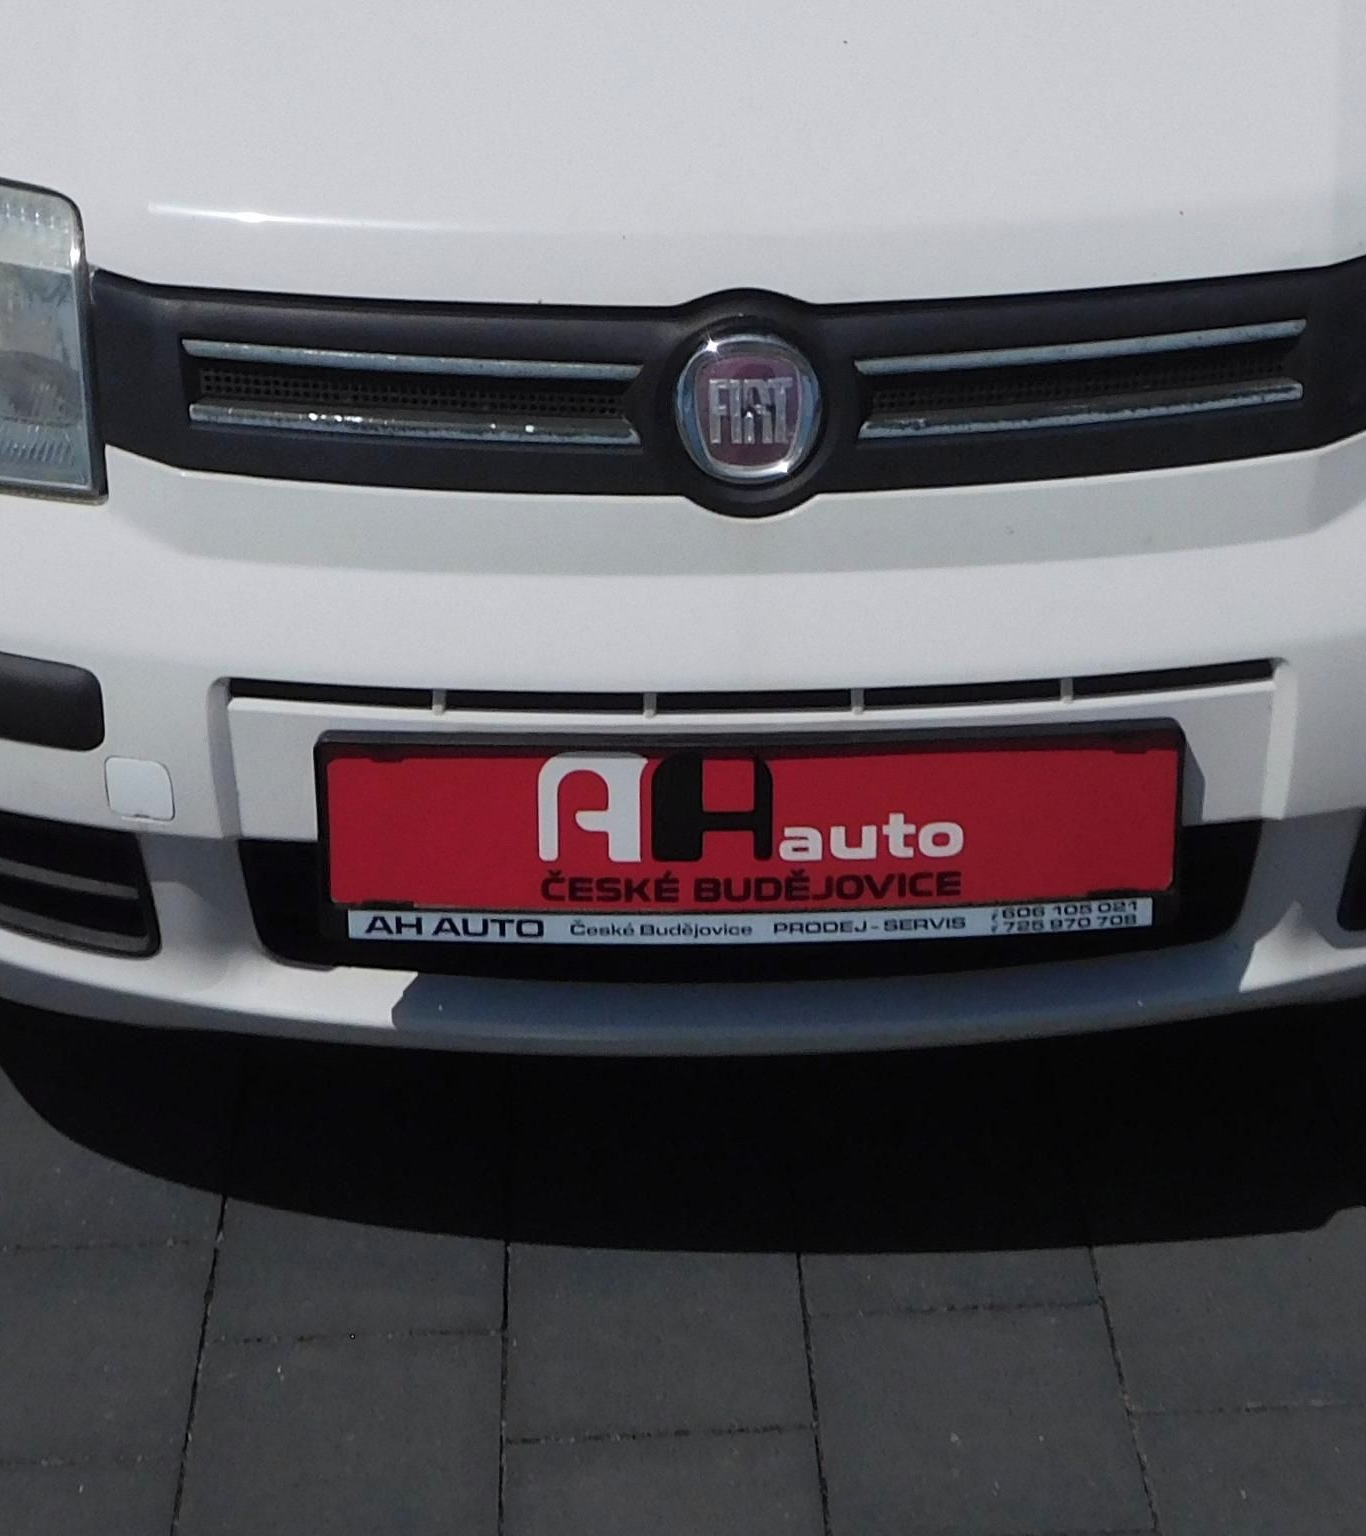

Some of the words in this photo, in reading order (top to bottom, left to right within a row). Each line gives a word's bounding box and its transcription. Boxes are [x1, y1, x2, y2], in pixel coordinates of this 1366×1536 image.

[708, 376, 793, 445] FIAT
[540, 869, 681, 903] ČESKÉ
[693, 869, 962, 903] BUDĚJOVICE
[364, 915, 424, 936] AH
[431, 917, 545, 938] AUTO
[569, 919, 635, 937] České
[639, 921, 753, 939] Budějovice
